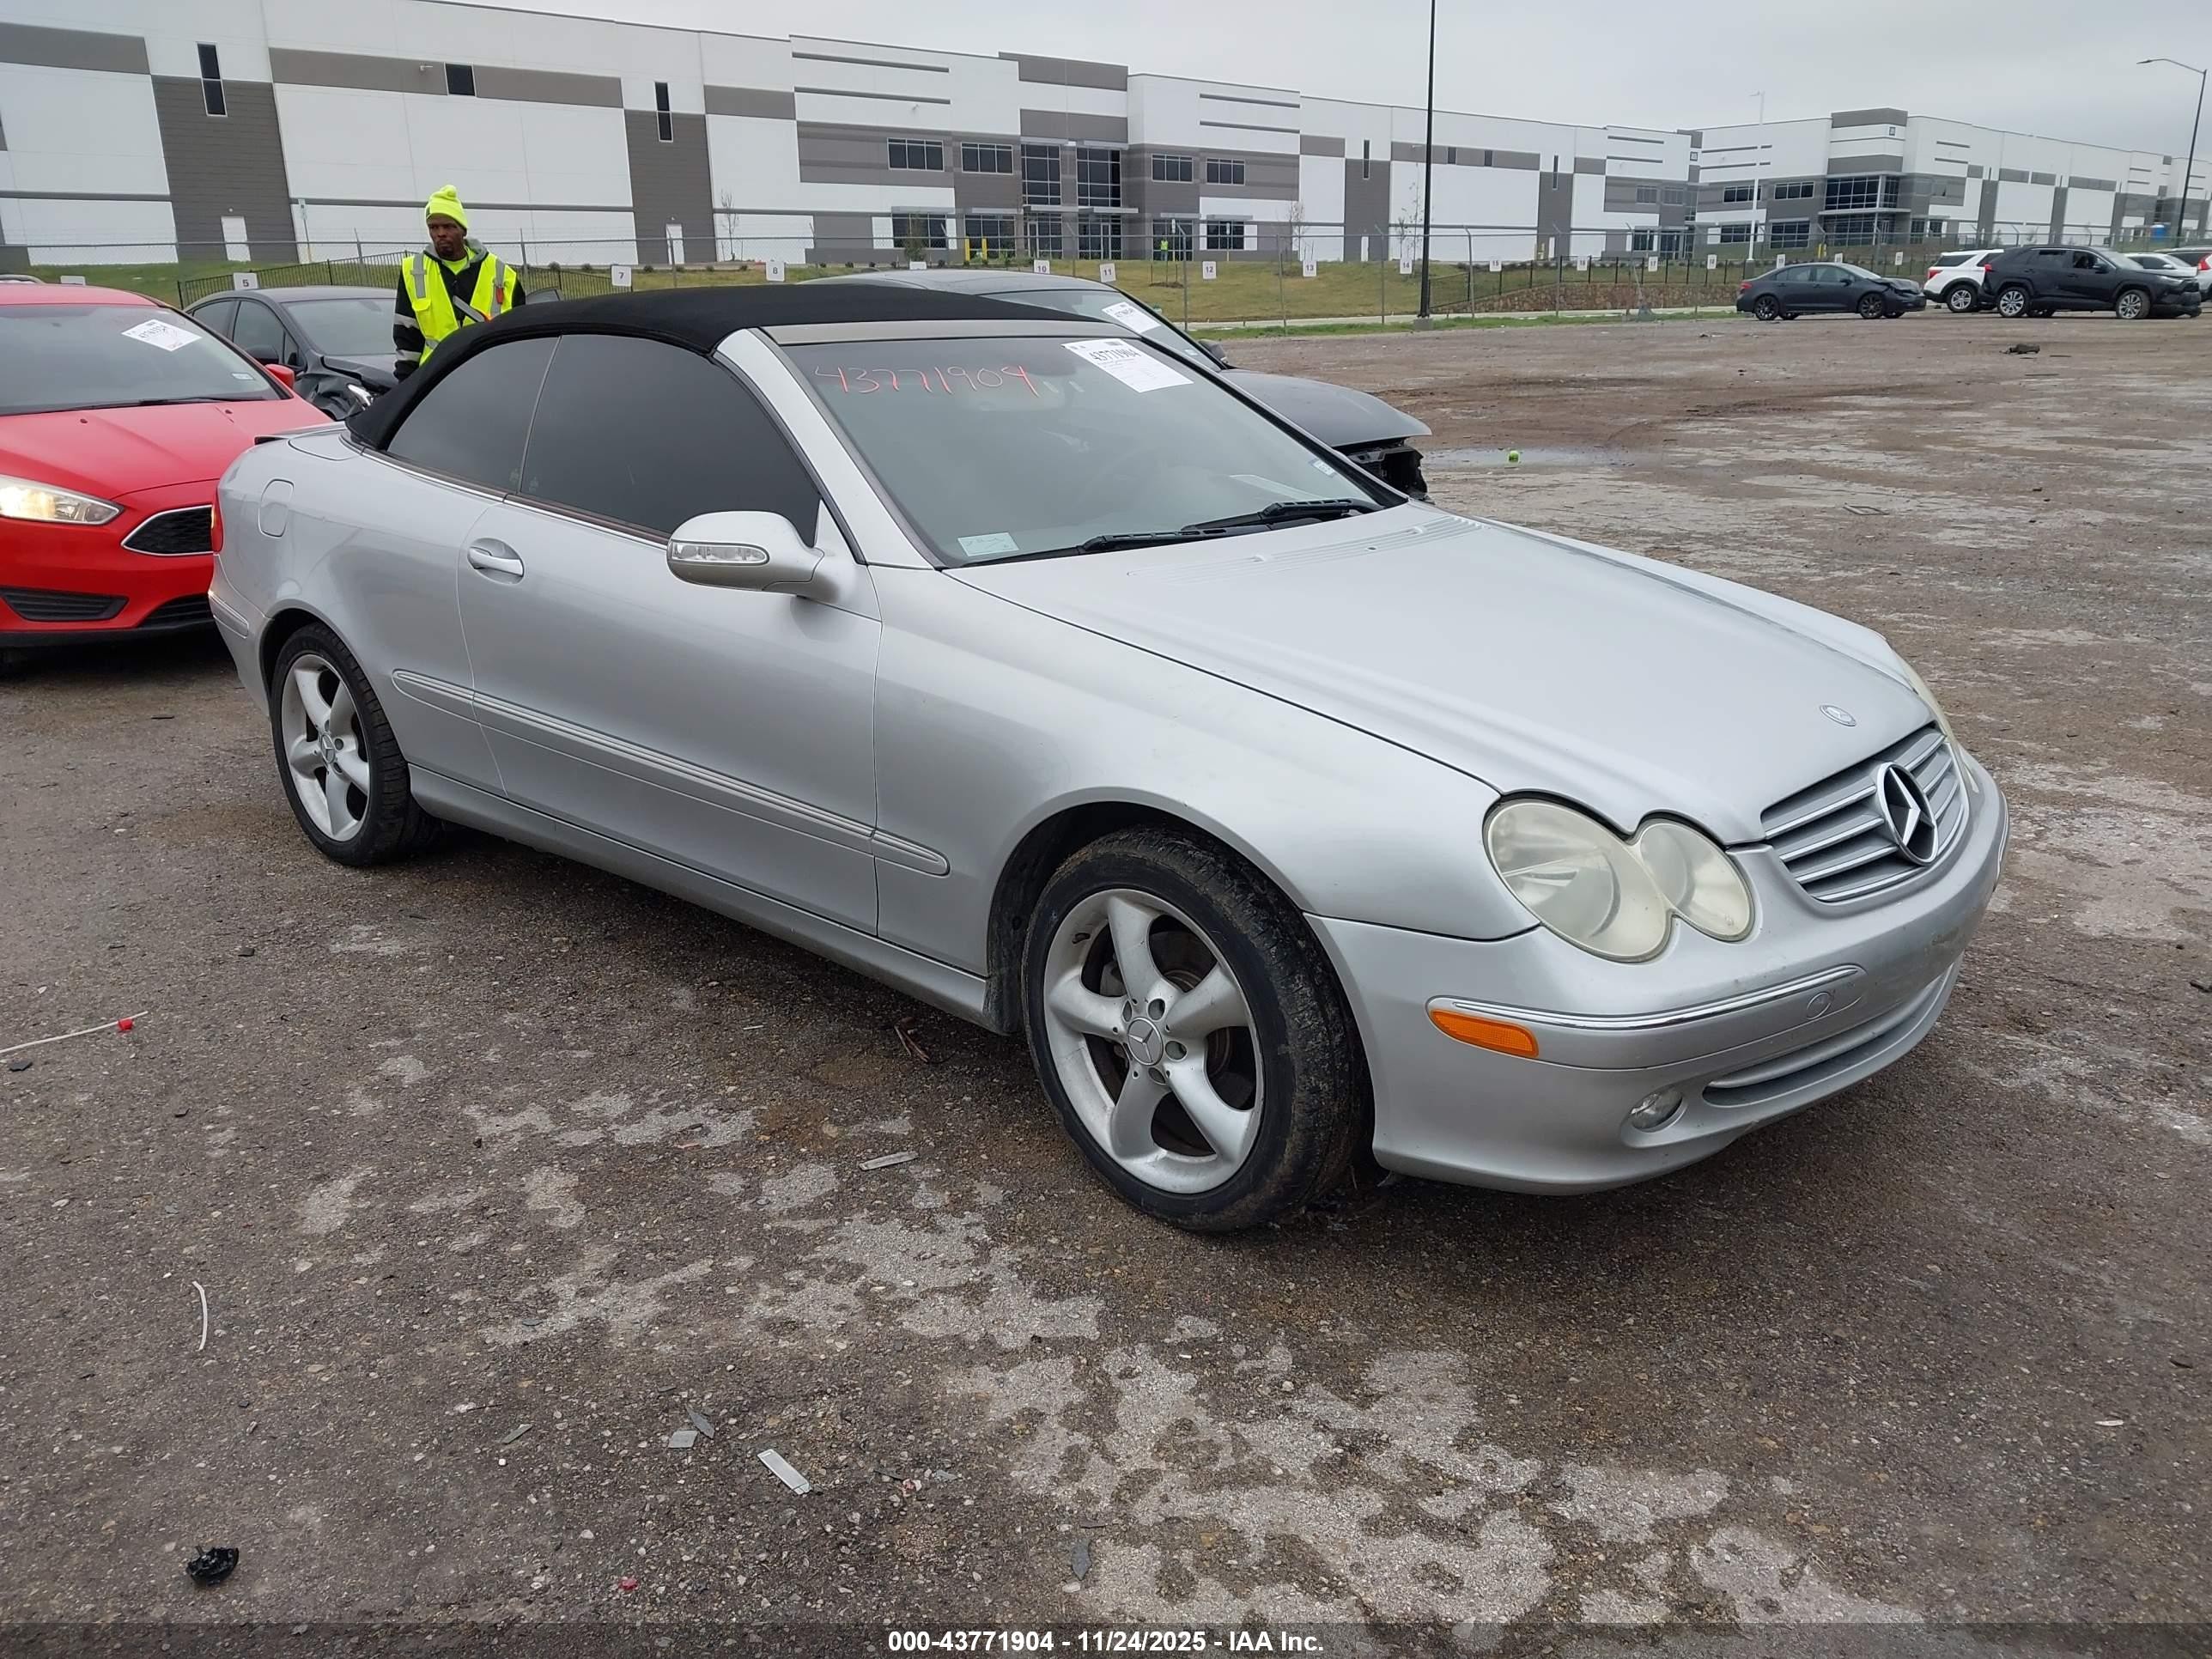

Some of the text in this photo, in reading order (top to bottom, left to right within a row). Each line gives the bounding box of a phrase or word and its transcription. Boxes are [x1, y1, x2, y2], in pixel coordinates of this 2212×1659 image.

[773, 266, 778, 275] 8
[242, 279, 249, 288] 5
[815, 366, 1039, 398] 43771904
